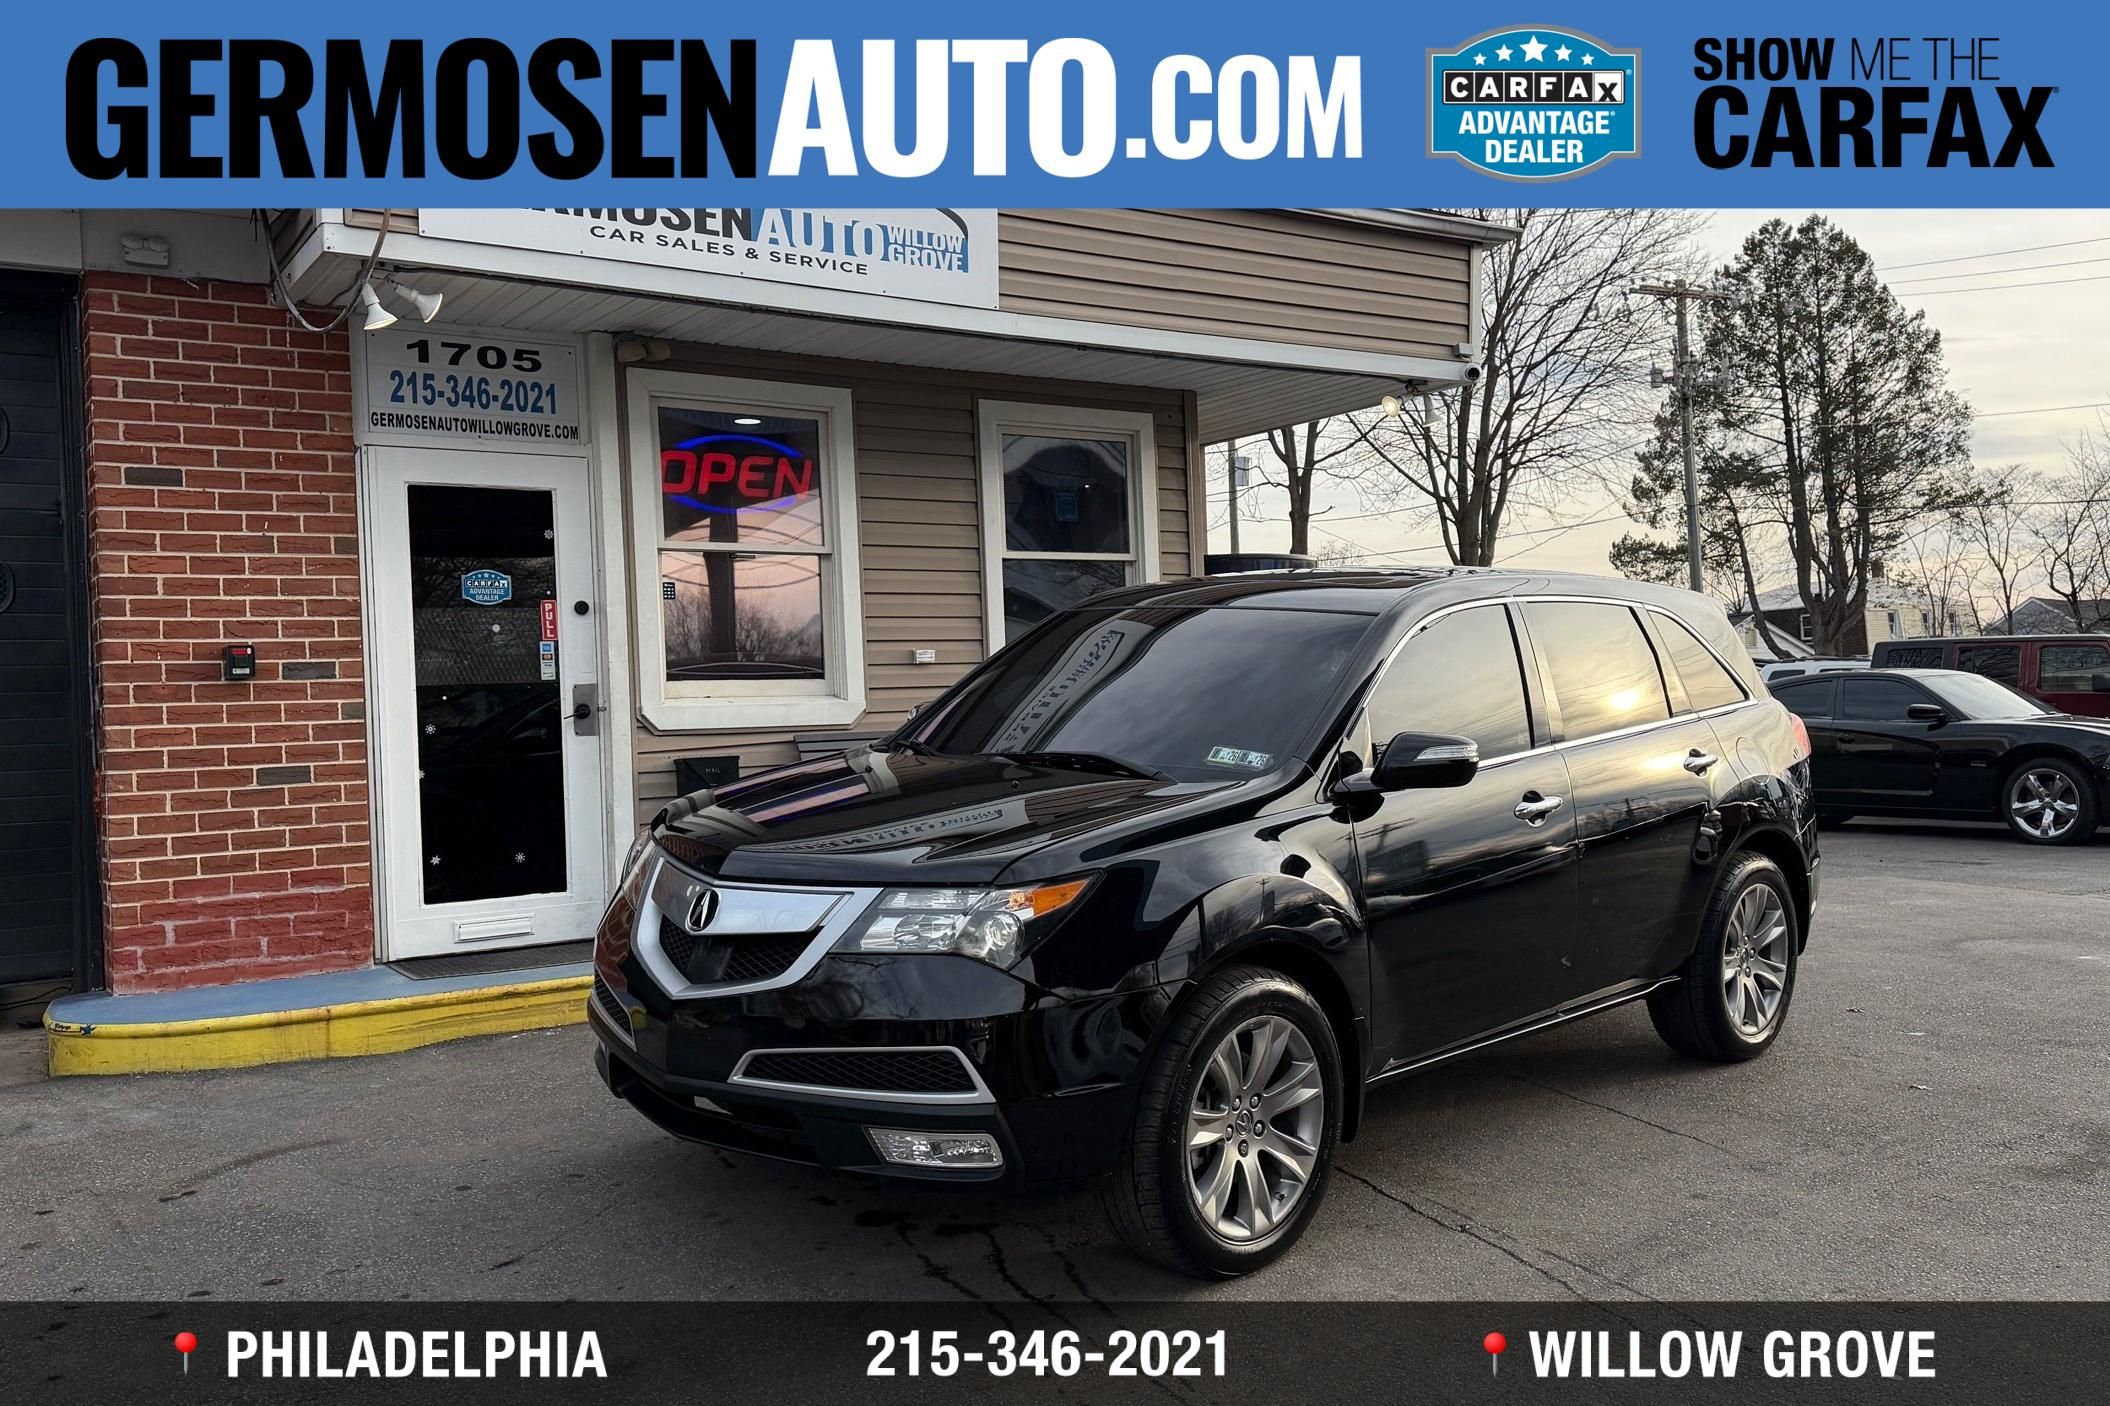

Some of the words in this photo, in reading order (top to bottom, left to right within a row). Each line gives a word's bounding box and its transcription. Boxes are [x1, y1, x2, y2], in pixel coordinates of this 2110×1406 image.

[590, 225, 646, 244] CAR
[656, 234, 736, 256] SALES
[745, 247, 760, 260] &
[769, 251, 868, 276] SERVICE
[887, 224, 964, 252] WILLOW
[887, 243, 964, 272] GROVE
[406, 339, 543, 373] 1705
[389, 369, 557, 415] 215-346-2021
[370, 411, 580, 441] GERMOSENAUTOWILLOWGROVE.COM
[661, 450, 814, 499] OPEN
[466, 580, 507, 588] CARFAX
[544, 603, 555, 638] PULL
